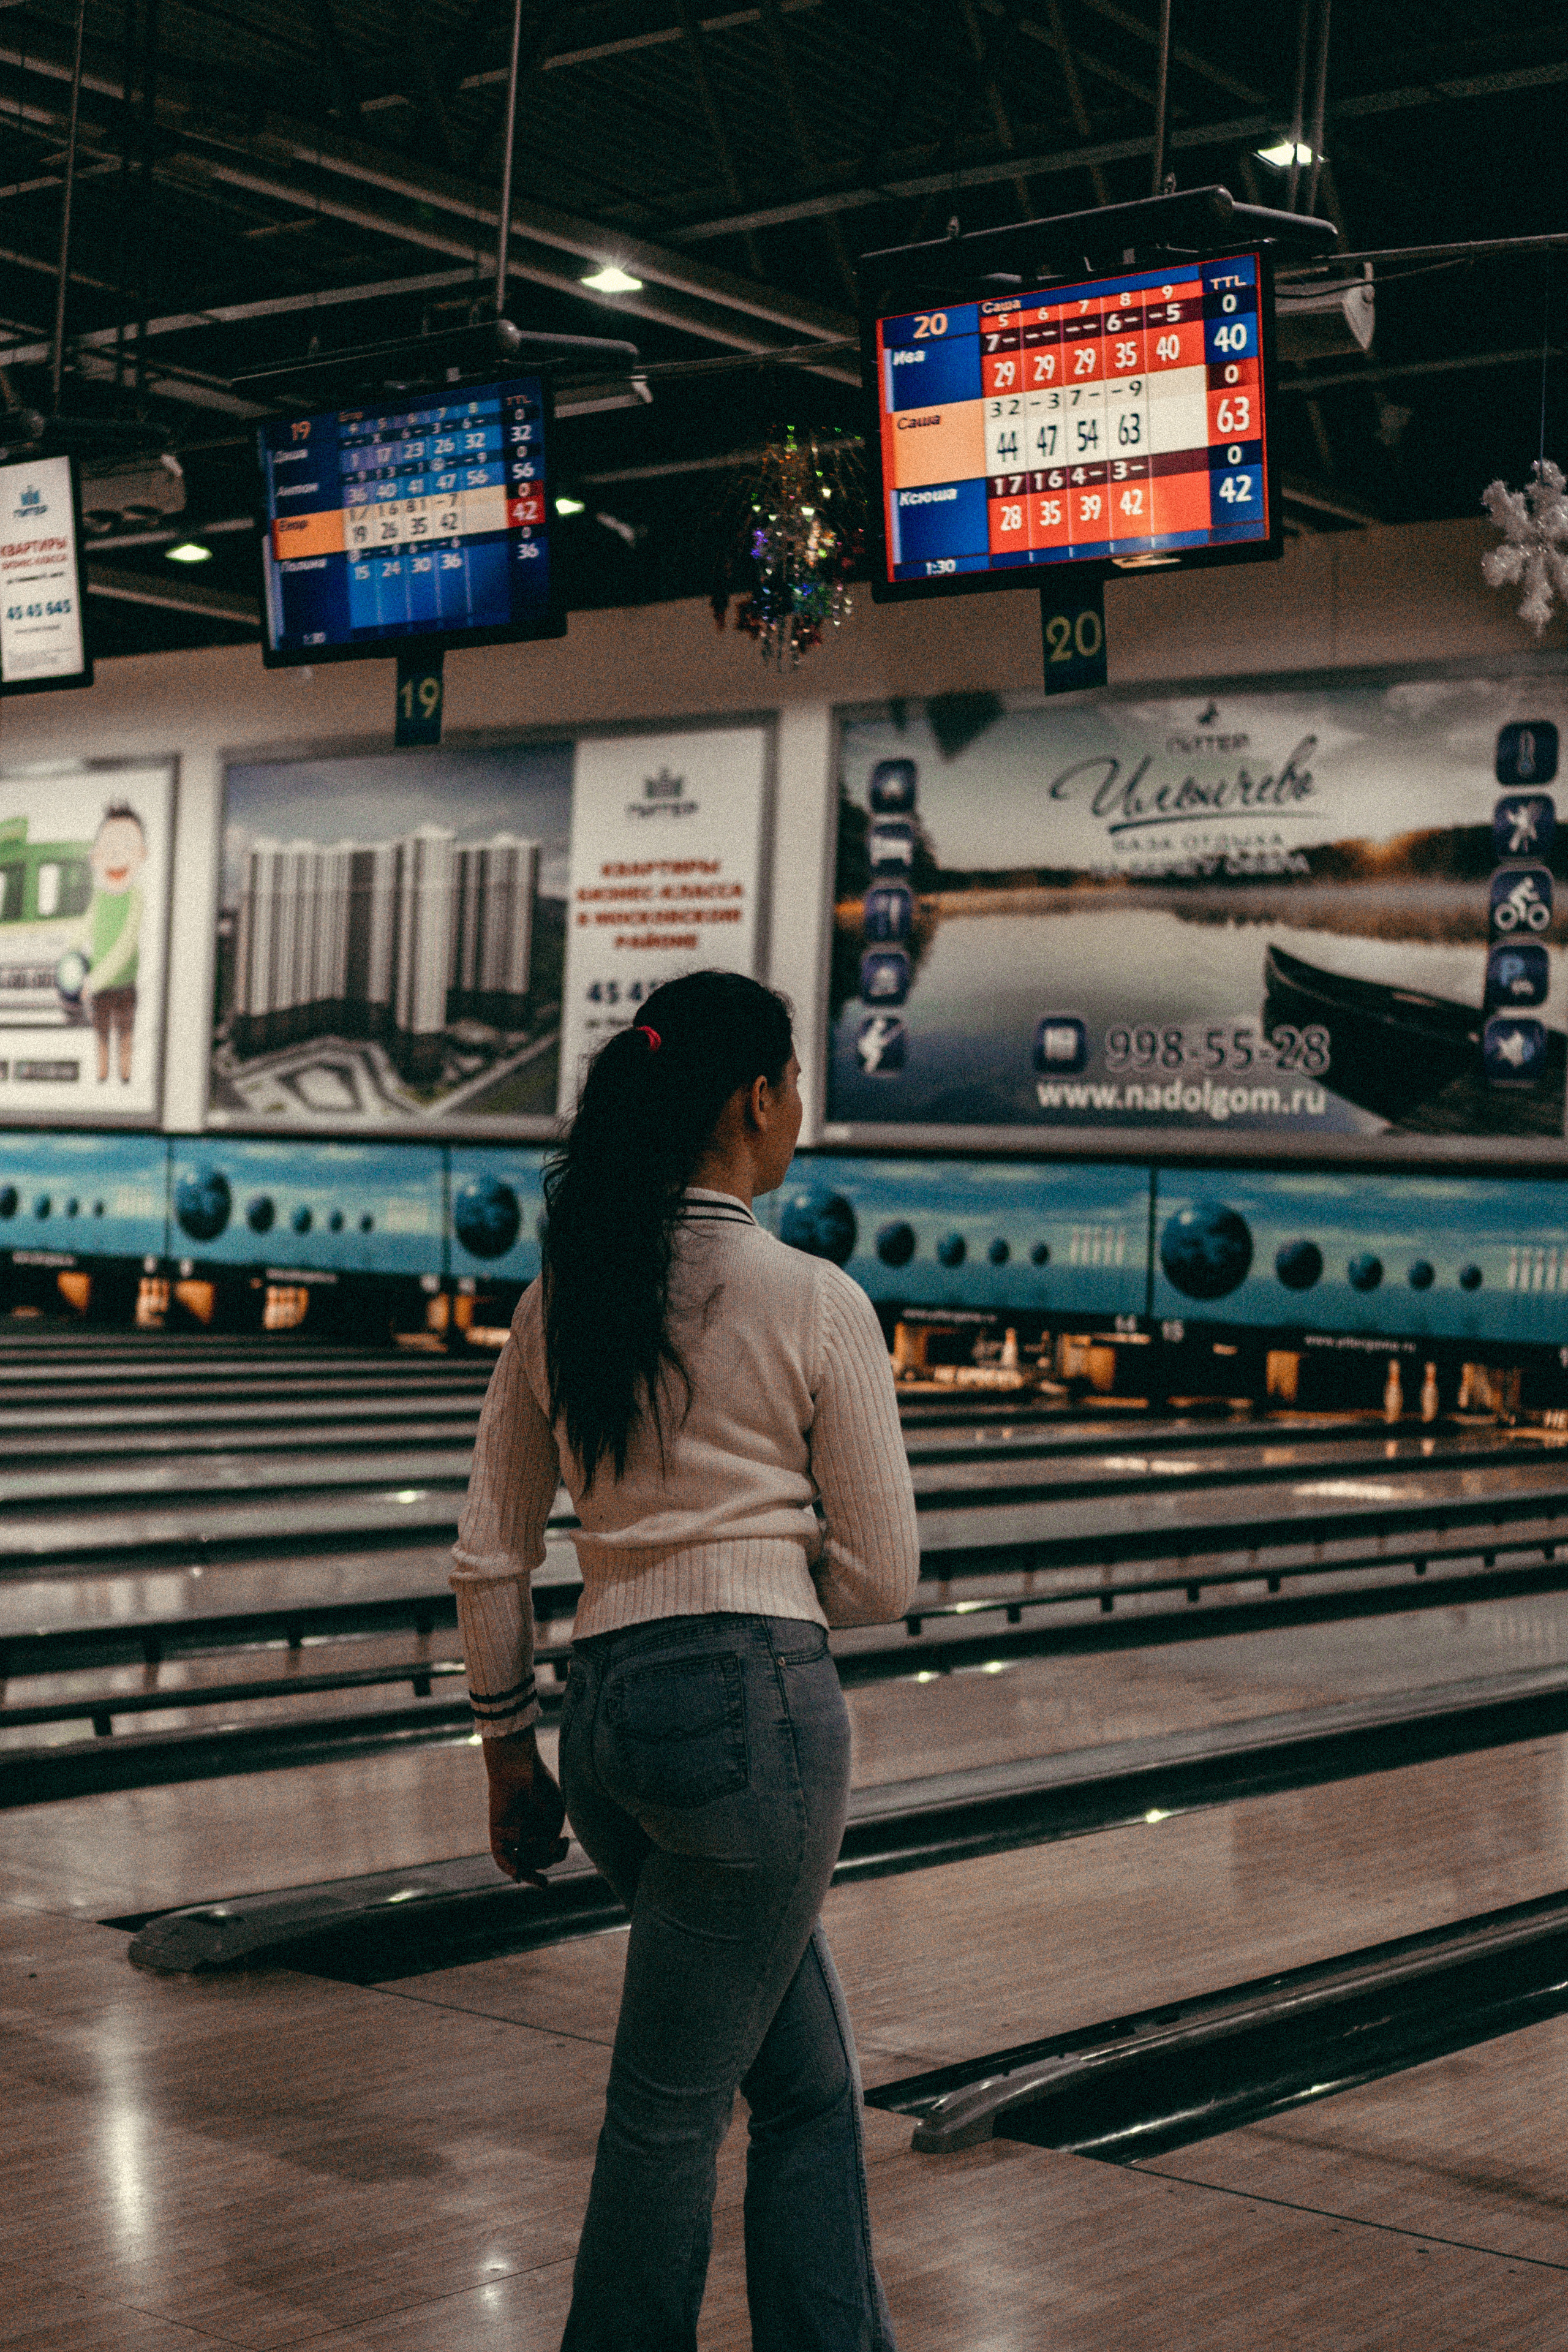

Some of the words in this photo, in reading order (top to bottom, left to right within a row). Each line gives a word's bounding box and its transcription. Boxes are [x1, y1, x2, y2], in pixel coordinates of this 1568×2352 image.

[1210, 275, 1247, 289] TTL
[982, 299, 1021, 314] Саша
[998, 314, 1009, 328] 5
[1038, 307, 1049, 320] 6
[1078, 300, 1090, 314] 7
[1120, 292, 1131, 306] 8
[1162, 285, 1174, 300] 9
[1222, 293, 1237, 312] 0
[913, 312, 948, 339] 20
[1213, 323, 1248, 353] 40
[993, 360, 1016, 388] 29
[1033, 353, 1055, 381] 29
[1074, 347, 1096, 375] 29
[1115, 341, 1137, 368] 35
[1156, 334, 1180, 361] 40
[1224, 365, 1240, 383] 0
[437, 407, 447, 420] 7
[468, 402, 478, 414] 8
[514, 409, 525, 420] 0
[1216, 396, 1250, 434] 63
[290, 421, 311, 440] 19
[897, 413, 941, 431] Саша
[511, 424, 532, 442] 32
[997, 431, 1017, 462] 44
[1036, 425, 1057, 457] 47
[1077, 419, 1098, 451] 54
[1119, 413, 1140, 445] 63
[375, 447, 392, 463] 17
[404, 442, 425, 459] 23
[434, 437, 455, 454] 26
[465, 432, 486, 449] 32
[516, 445, 527, 457] 0
[1227, 446, 1242, 465] 0
[512, 462, 535, 479] 56
[375, 483, 398, 499] 40
[408, 478, 425, 494] 41
[435, 473, 457, 489] 47
[466, 469, 489, 486] 56
[518, 483, 530, 497] 0
[1219, 474, 1252, 503] 42
[899, 487, 958, 507] Ксюша
[513, 500, 538, 521] 42
[1000, 505, 1022, 531] 28
[1040, 500, 1061, 526] 35
[1079, 494, 1102, 521] 39
[1120, 489, 1144, 516] 42
[353, 525, 368, 543] 19
[380, 521, 399, 540] 26
[410, 516, 428, 535] 35
[440, 513, 458, 530] 42
[522, 526, 532, 538] 0
[518, 543, 540, 559] 36
[354, 565, 370, 580] 15
[382, 561, 402, 577] 24
[411, 556, 432, 573] 30
[440, 552, 462, 570] 36
[925, 559, 956, 576] 1:30
[7, 605, 23, 620] 45
[26, 603, 43, 617] 45
[1046, 611, 1102, 663] 20
[401, 676, 440, 719] 19
[1105, 1025, 1330, 1076] 998-55-28
[1037, 1077, 1326, 1121] www.nadolgom.ru
